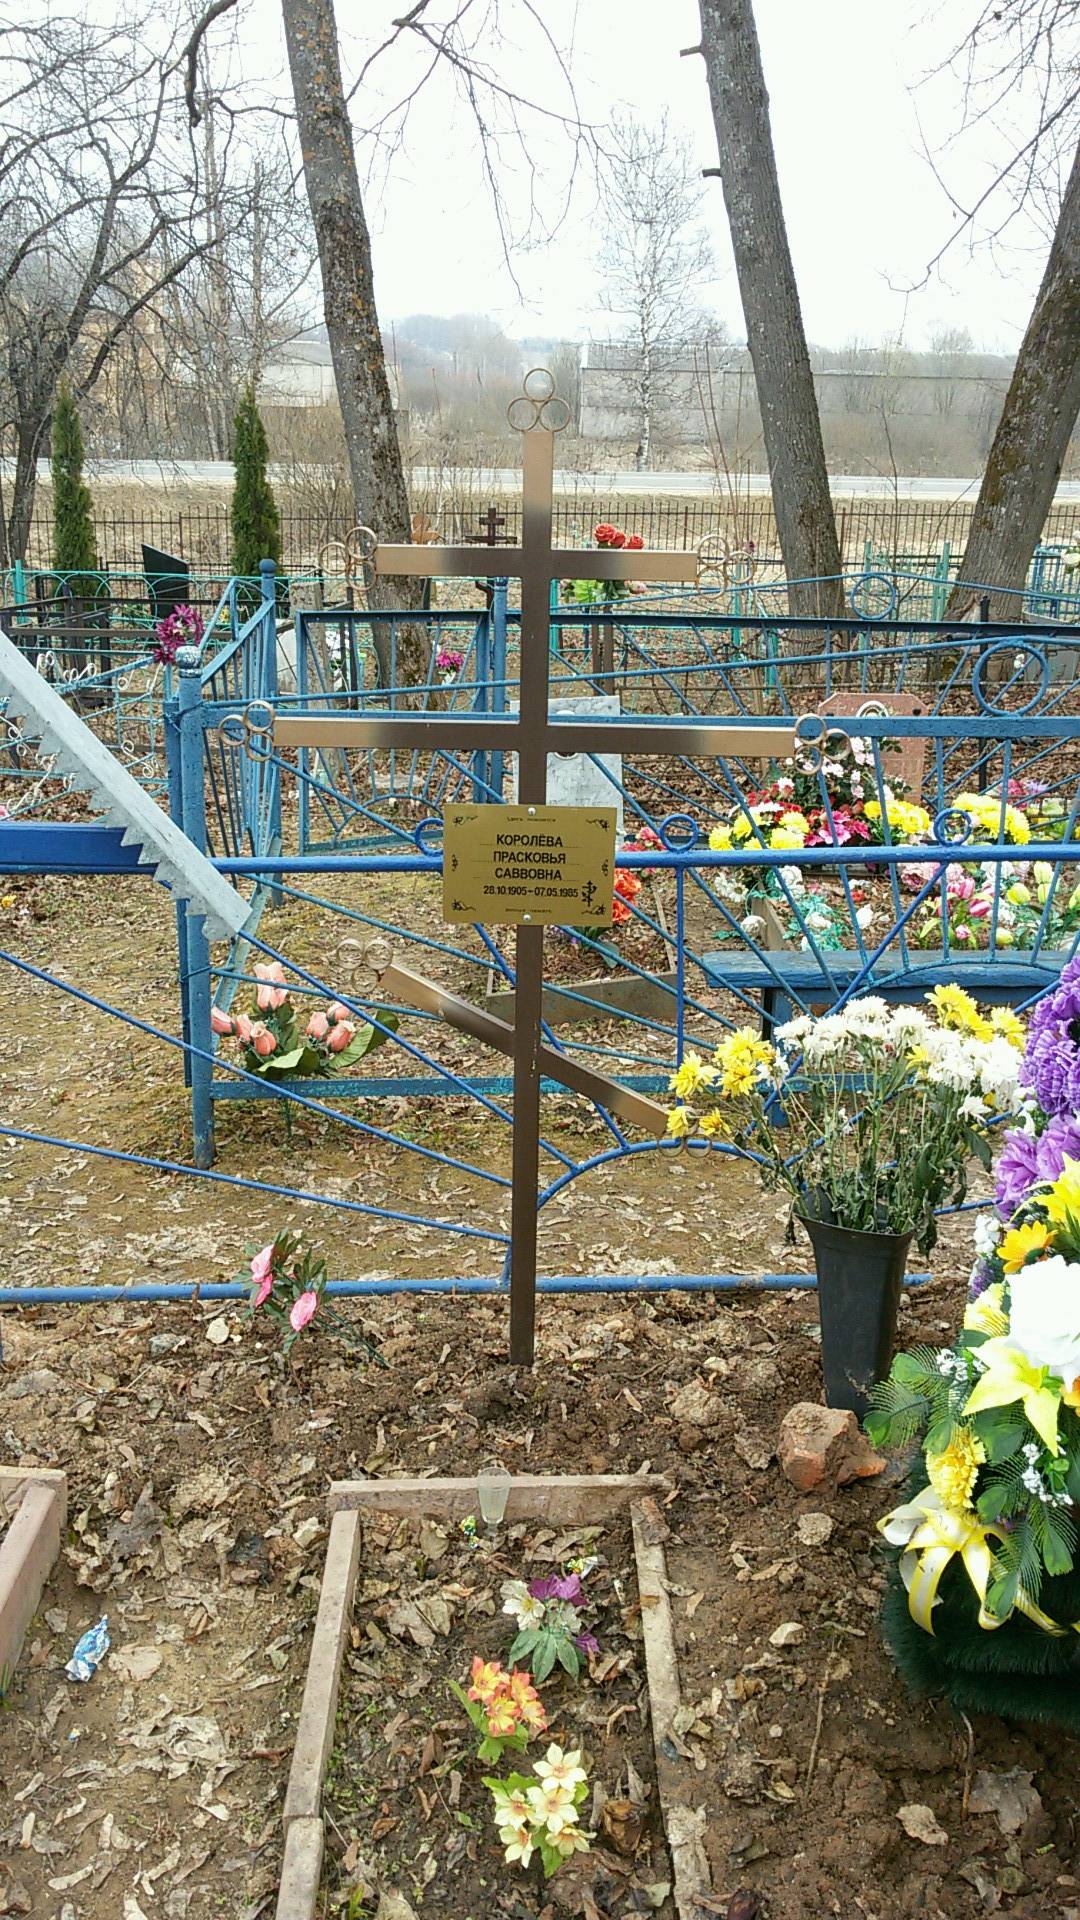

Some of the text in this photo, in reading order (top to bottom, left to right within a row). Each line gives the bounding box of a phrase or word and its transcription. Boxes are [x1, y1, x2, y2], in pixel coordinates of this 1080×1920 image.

[496, 833, 563, 848] КОРОЛЁВА
[493, 851, 566, 865] ПРАСКОВЬЯ
[494, 867, 563, 881] САВВОВНА
